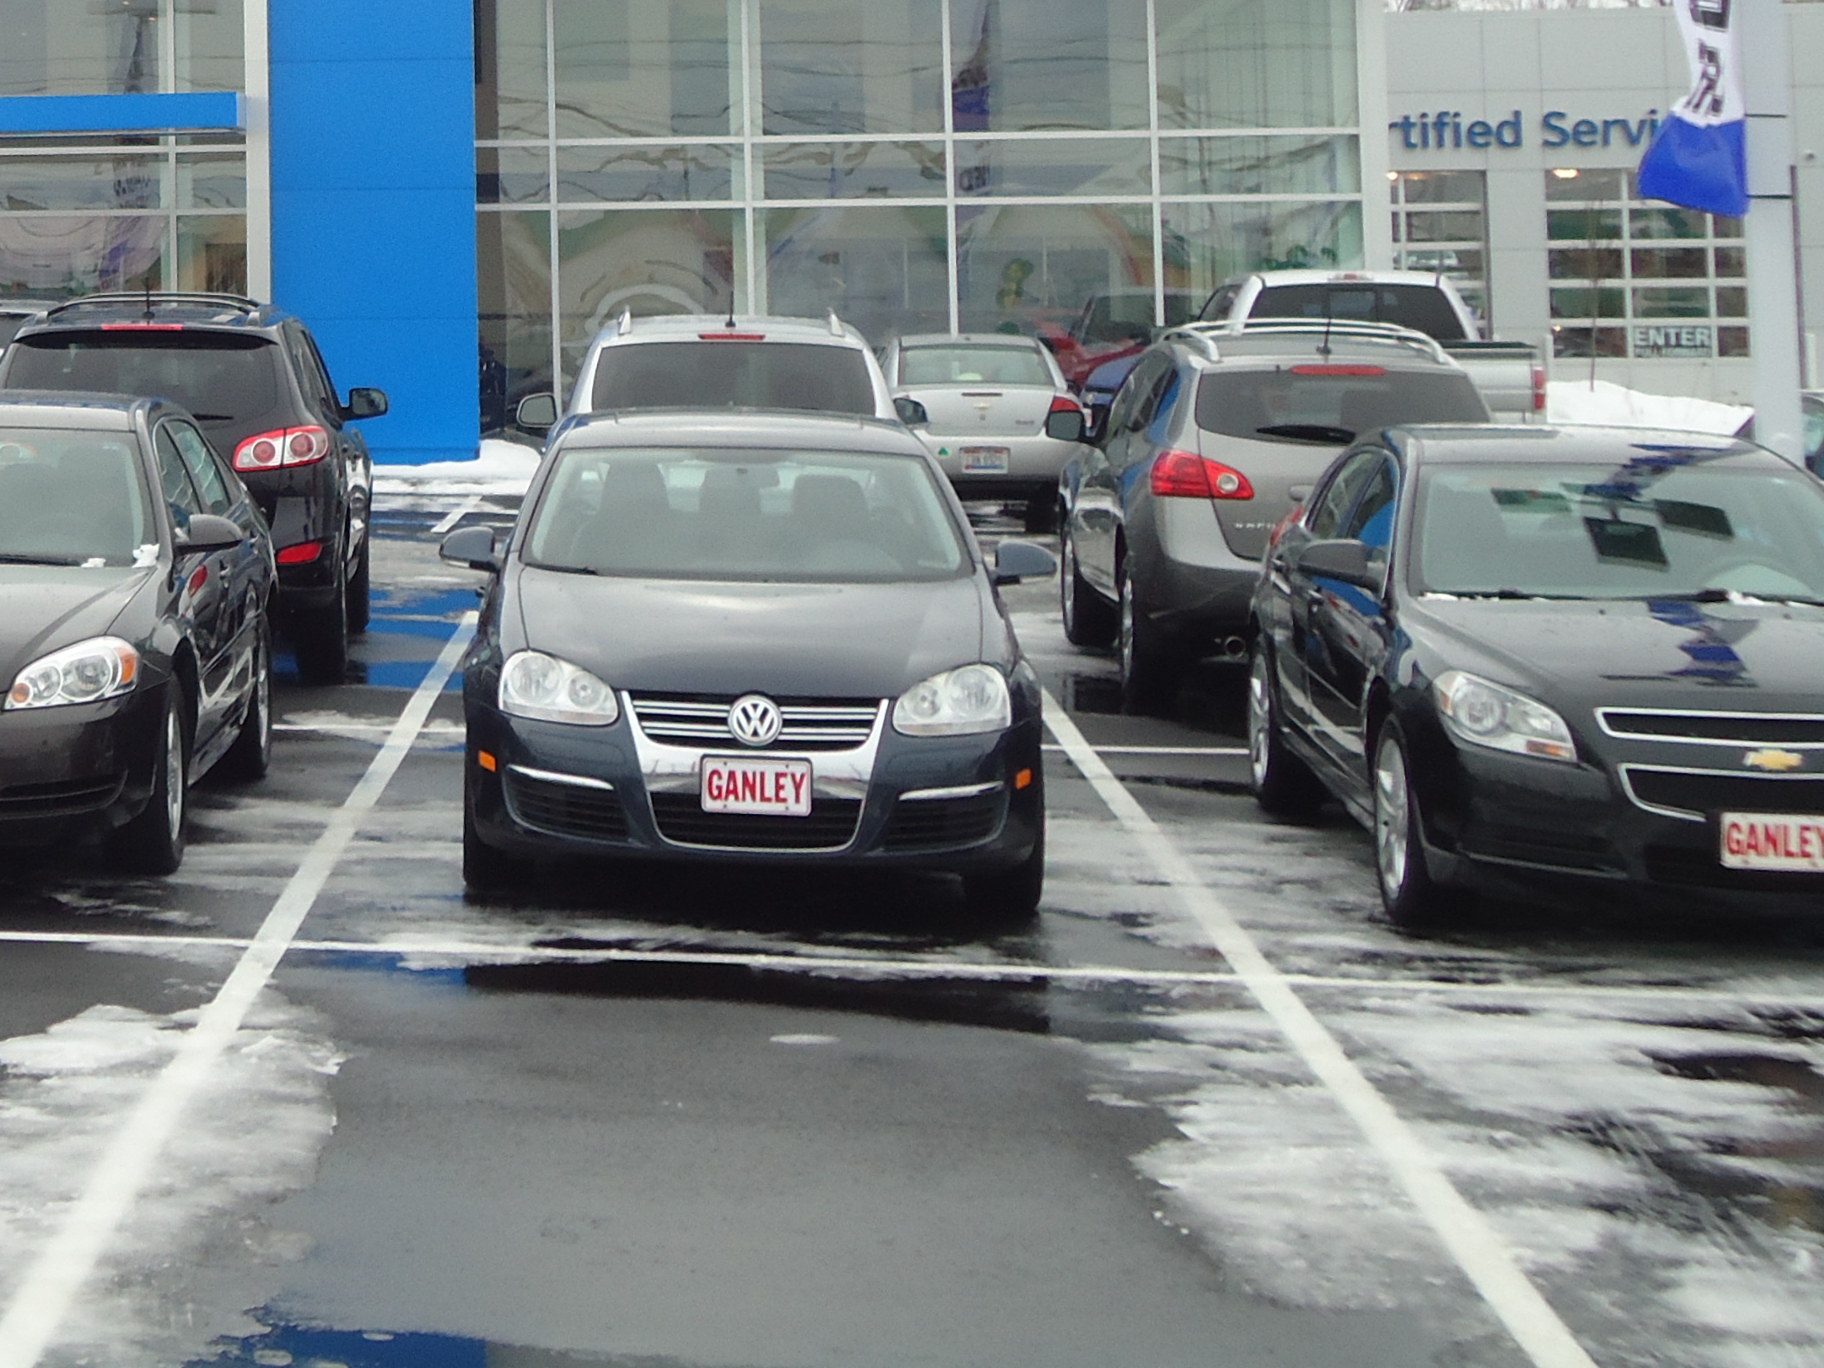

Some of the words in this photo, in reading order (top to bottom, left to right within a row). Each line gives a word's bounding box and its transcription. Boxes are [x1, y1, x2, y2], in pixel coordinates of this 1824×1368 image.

[1542, 108, 1662, 148] Servi
[1635, 327, 1711, 346] ENTER
[707, 769, 806, 804] GANLEY
